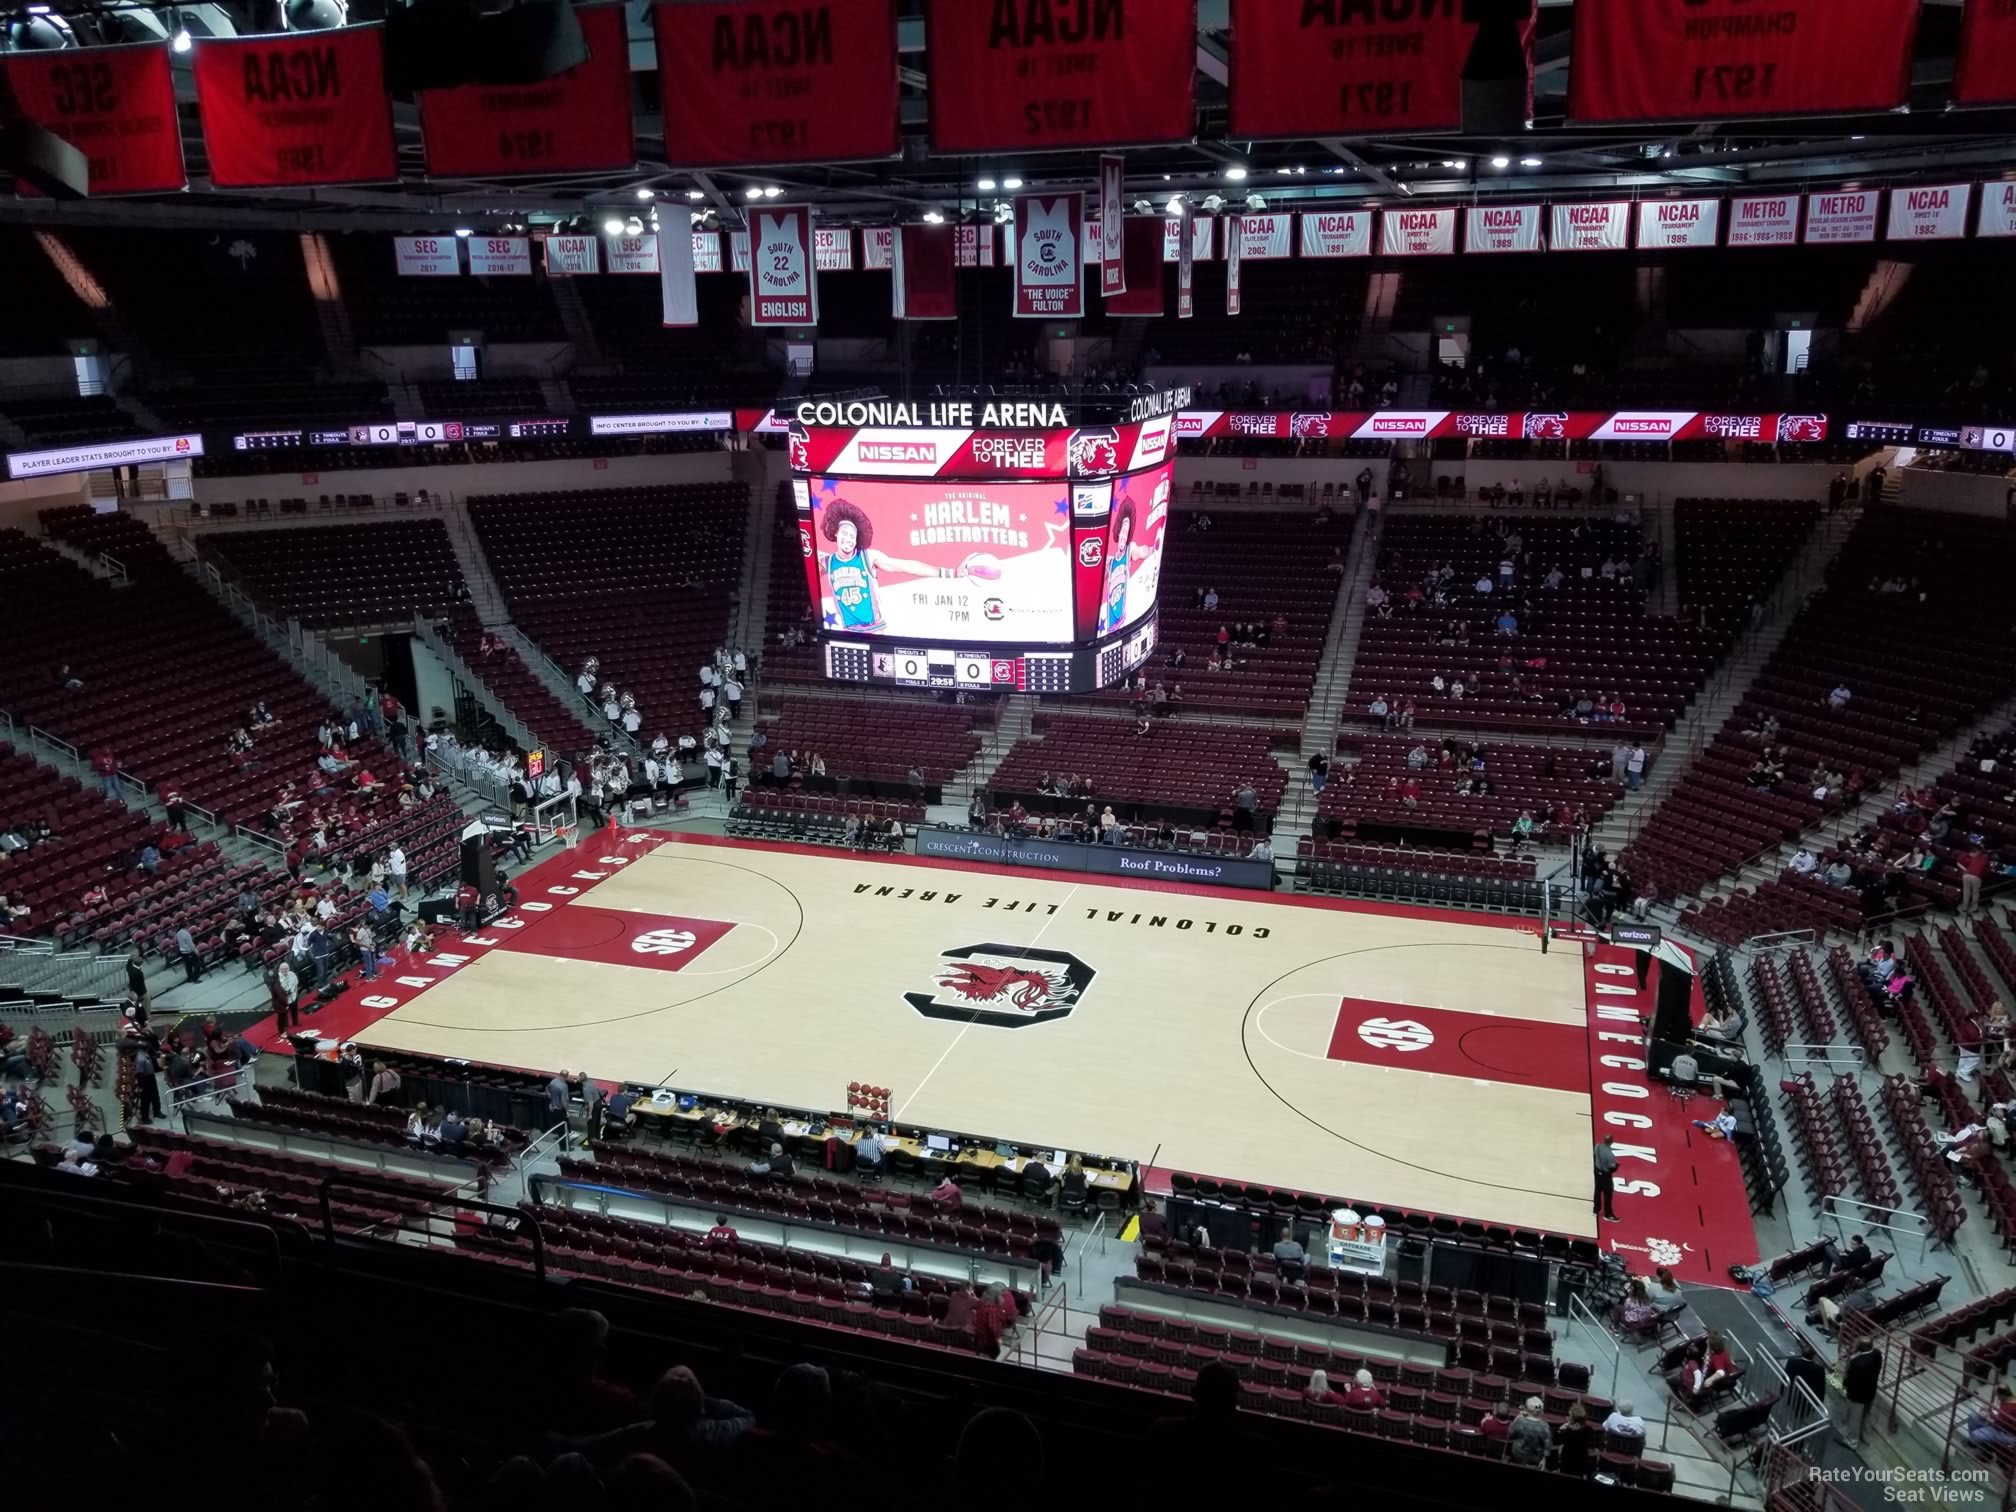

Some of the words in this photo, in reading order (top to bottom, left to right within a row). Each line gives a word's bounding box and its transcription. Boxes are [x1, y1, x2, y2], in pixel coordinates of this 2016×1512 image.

[1819, 195, 1865, 215] METRO
[1907, 190, 1949, 210] NCAA
[1569, 207, 1609, 224] NCAA
[1658, 204, 1700, 221] NCAA
[1742, 201, 1786, 219] METRO
[1239, 218, 1275, 234] NCAA
[1318, 216, 1355, 233] NCAA
[1400, 214, 1437, 230] NCAA
[1484, 210, 1523, 227] NCAA
[1165, 219, 1197, 236] NCA
[1914, 225, 1936, 235] 1982
[876, 231, 892, 246] NC
[1033, 229, 1063, 242] SOUTH
[1667, 234, 1688, 244] 1986
[414, 240, 438, 253] SEC
[488, 240, 511, 253] SEC
[558, 239, 586, 253] NCAA
[622, 239, 642, 251] SEC
[767, 242, 794, 255] SOUTH
[1248, 247, 1267, 255] 2002
[1327, 244, 1345, 253] 1991
[1407, 242, 1428, 251] 1990
[420, 264, 437, 272] 2017
[773, 256, 789, 271] 22
[1027, 259, 1069, 277] CAROLINA
[762, 270, 801, 287] CAROLINA
[1023, 288, 1043, 300] "THE
[1045, 288, 1074, 300] VOICE"
[761, 302, 806, 317] ENGLISH
[1033, 300, 1064, 311] FULTON
[1131, 393, 1163, 422] COLONIAL
[1162, 391, 1174, 414] LIFE
[1173, 387, 1191, 410] ARENA
[800, 403, 922, 427] COLONIAL
[930, 403, 972, 428] LIFE
[980, 403, 1068, 428] ARENA
[1230, 415, 1277, 423] FOREVER
[1456, 415, 1508, 424] FOREVER
[1705, 416, 1761, 425] FOREVER
[425, 426, 435, 438] 0
[1177, 420, 1201, 429] SAN
[1242, 423, 1276, 434] THEE
[1373, 420, 1425, 430] NISSAN
[1468, 424, 1507, 435] THEE
[1615, 421, 1670, 431] NISSAN
[1706, 424, 1719, 432] TO
[1719, 425, 1760, 436] THEE
[380, 428, 389, 440] 0
[1993, 432, 2006, 447] 0
[973, 438, 1045, 452] FOREVER
[22, 459, 51, 469] PLAYER
[52, 456, 80, 466] LEADER
[81, 453, 102, 462] STATS
[103, 450, 136, 459] BROUGHT
[859, 444, 935, 462] NISSAN
[973, 451, 990, 462] TO
[991, 451, 1045, 468] THEE
[959, 492, 986, 500] ORIGINAL
[924, 501, 1010, 528] HARLEM
[911, 526, 1029, 548] GLOBETROTTERS
[912, 593, 928, 605] FRI
[935, 595, 953, 607] JAN
[959, 595, 969, 608] 12
[949, 610, 970, 622] 7PM
[905, 659, 917, 675] 0
[967, 663, 980, 679] 0
[485, 815, 506, 823] verizon
[927, 841, 971, 854] CRESCENT
[978, 847, 1059, 862] CONSTRUCTION
[1120, 857, 1150, 871] Roof
[1154, 860, 1222, 877] Problems?
[853, 883, 962, 904] ARENA
[982, 897, 1059, 915] LIFE
[1087, 908, 1271, 940] COLONIAL
[631, 929, 697, 955] SEC
[1619, 930, 1651, 940] verizon
[1358, 1017, 1434, 1051] SEC
[1679, 1059, 1693, 1067] CREW
[1594, 963, 1661, 1198] GAMECOCKS
[1339, 1242, 1371, 1252] GATORADE
